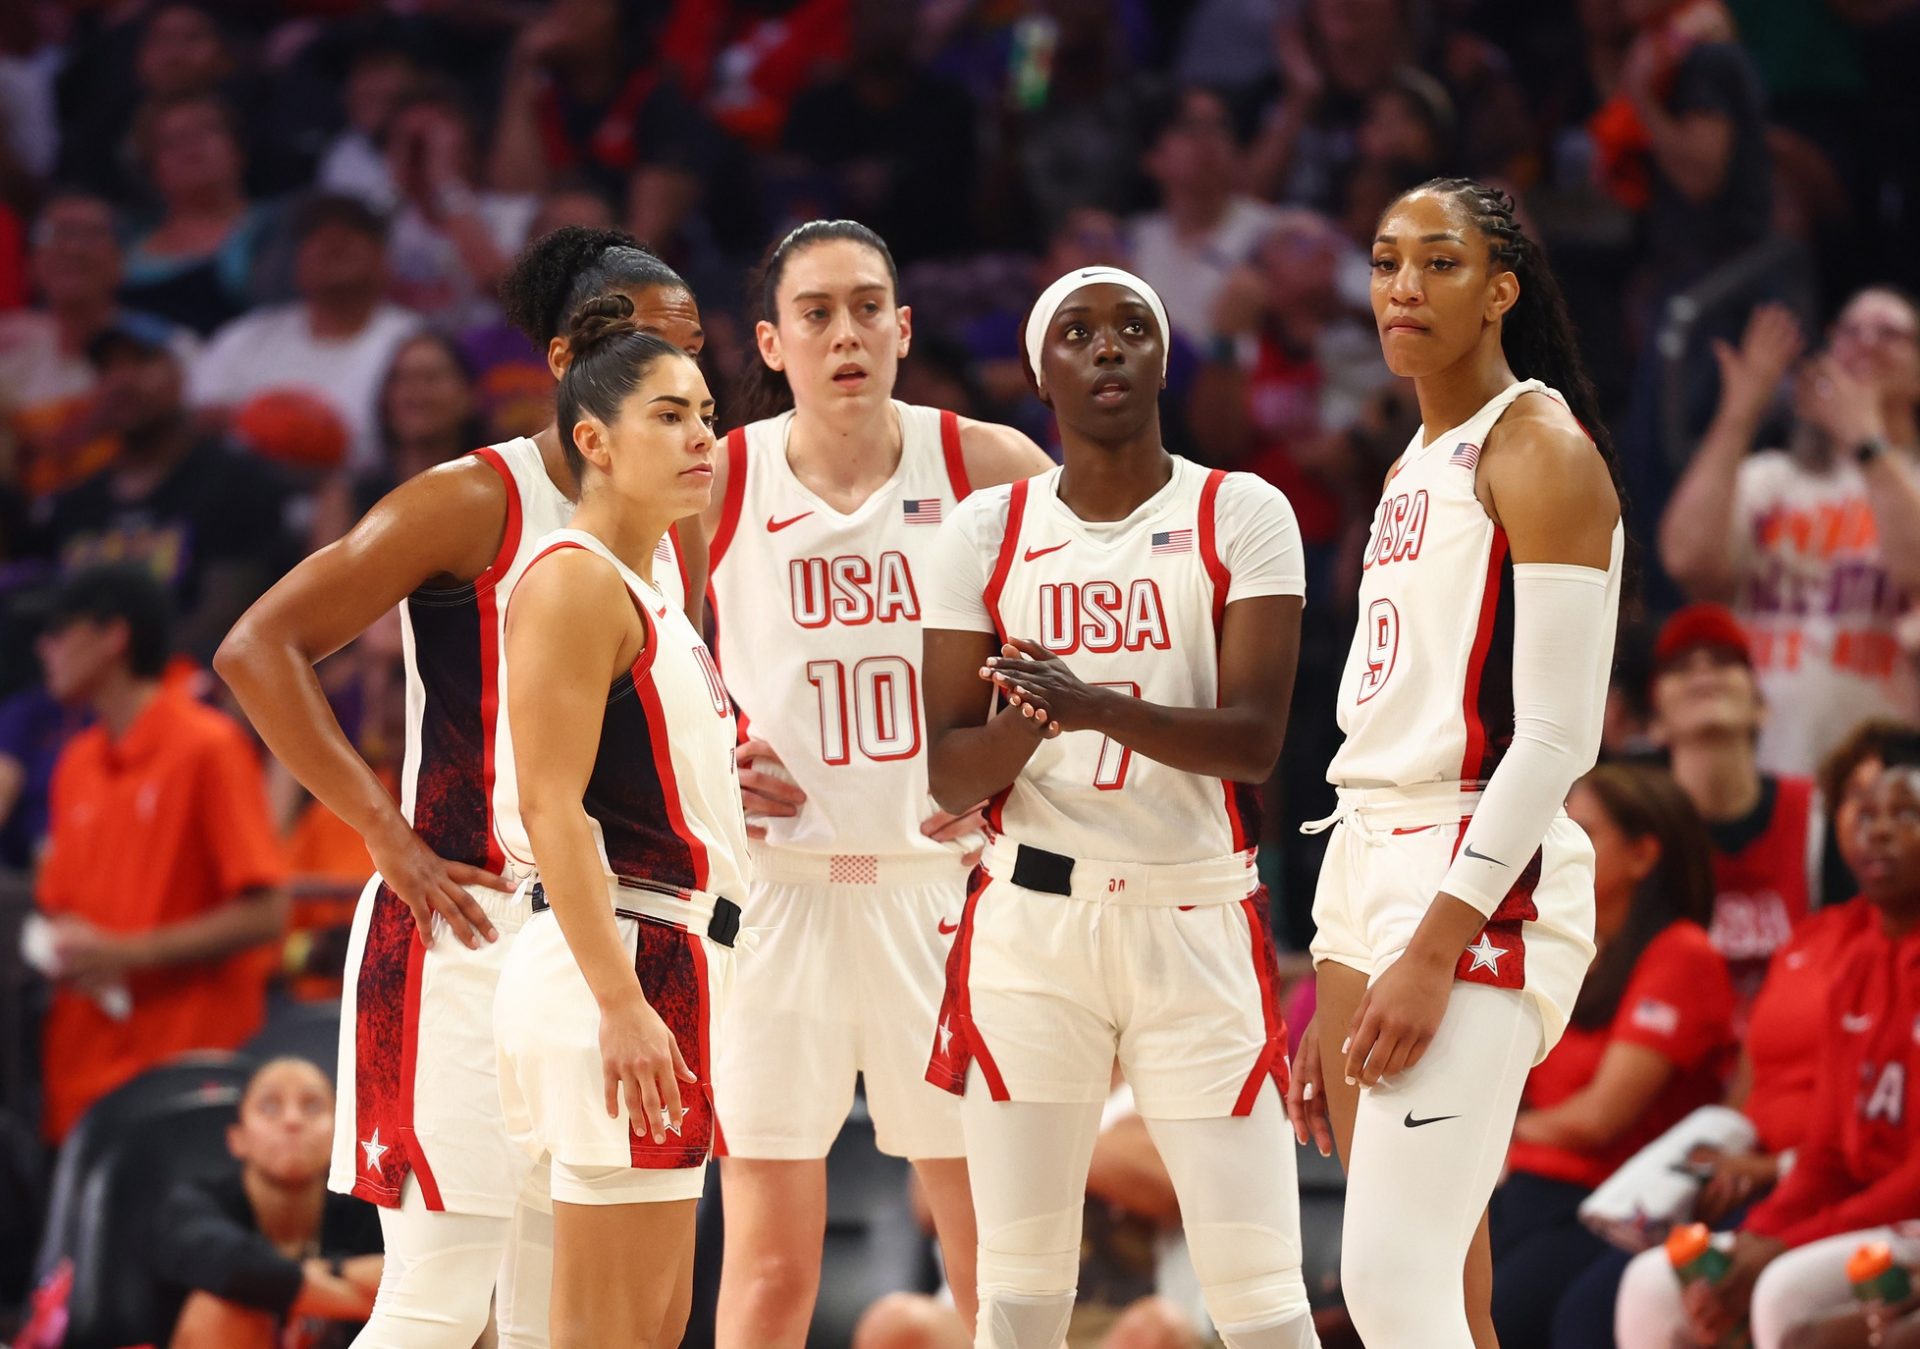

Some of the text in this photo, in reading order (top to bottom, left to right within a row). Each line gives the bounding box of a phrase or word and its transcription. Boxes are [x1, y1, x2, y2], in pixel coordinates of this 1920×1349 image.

[1363, 489, 1428, 570] USA
[789, 551, 921, 628] USA
[1040, 579, 1171, 655] USA
[1357, 598, 1399, 705] 9
[807, 656, 921, 765] 10
